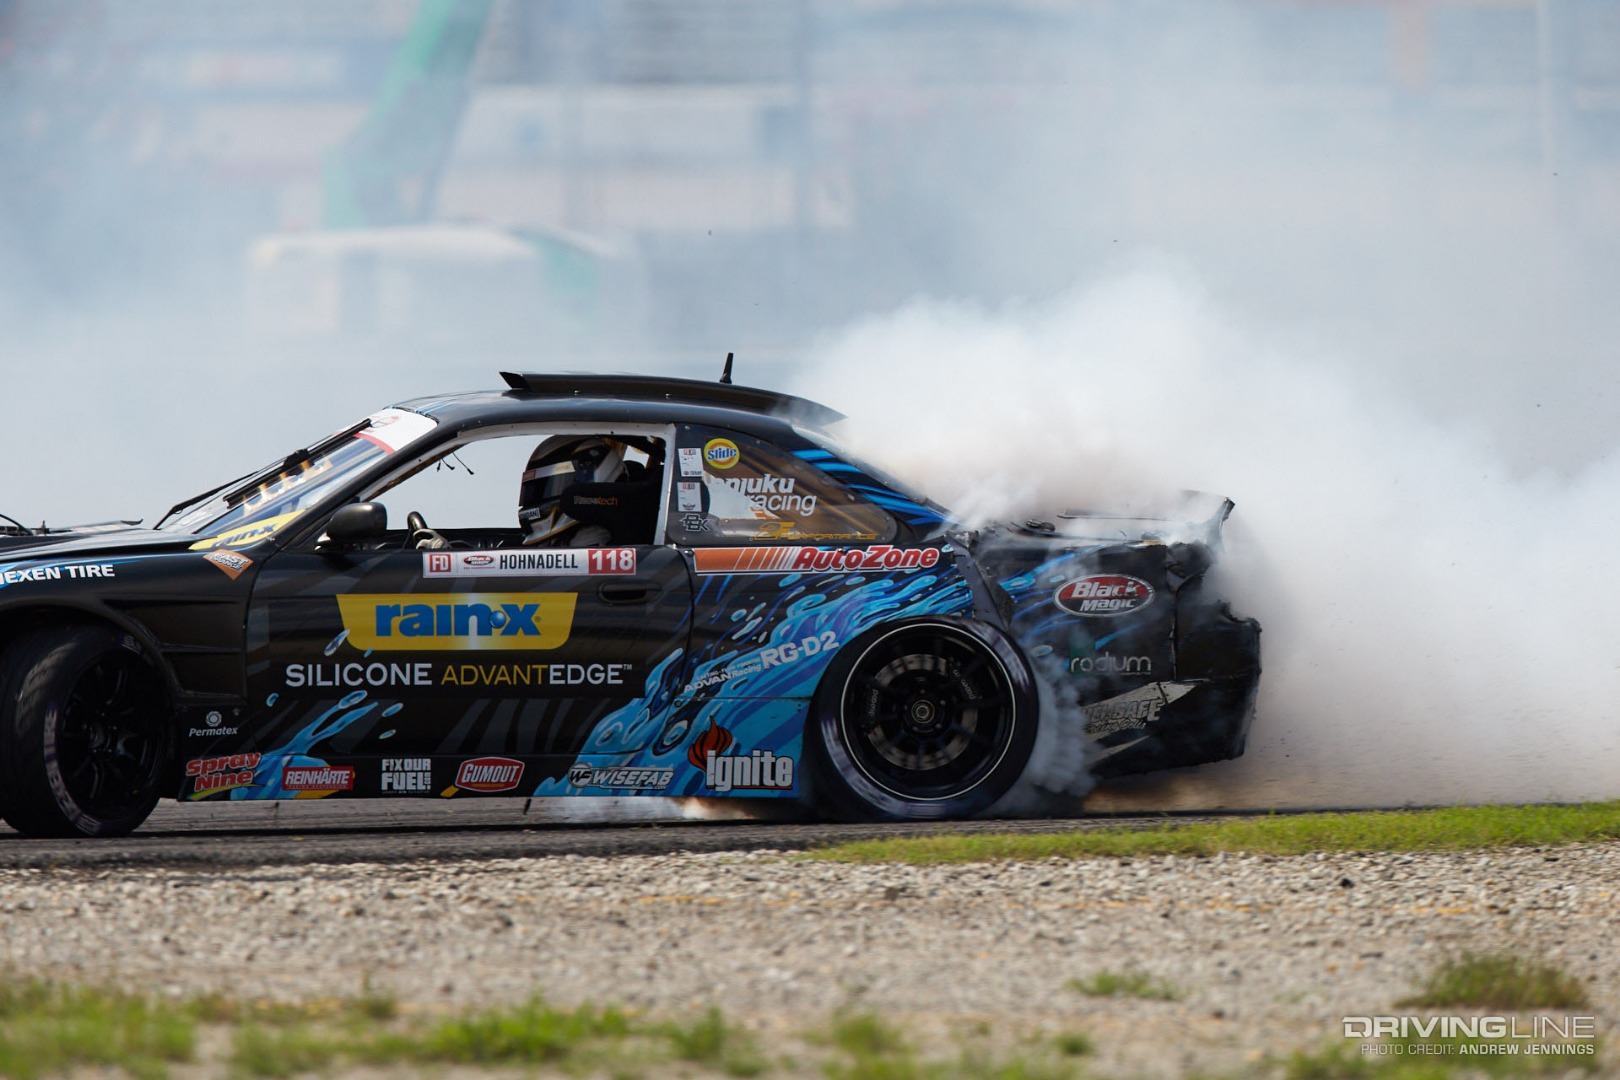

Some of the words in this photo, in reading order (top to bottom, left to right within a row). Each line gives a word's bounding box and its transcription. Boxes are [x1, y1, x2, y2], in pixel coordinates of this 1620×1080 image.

[710, 474, 795, 495] njuku
[432, 555, 449, 571] FD
[499, 553, 579, 570] HOHNADELL
[591, 550, 633, 571] 118
[792, 545, 940, 571] AutoZone
[0, 567, 61, 585] EXEN
[65, 564, 115, 579] TIRE
[1071, 581, 1140, 598] Black
[1079, 597, 1136, 612] Magic
[285, 663, 432, 687] SILICONE
[188, 725, 238, 738] Permatex
[185, 752, 262, 777] Spray
[461, 763, 520, 783] GUMOUT
[706, 750, 793, 791] ignite
[194, 769, 253, 792] Nine
[285, 768, 351, 785] REINHÄRTE
[592, 770, 674, 786] WISEFAB
